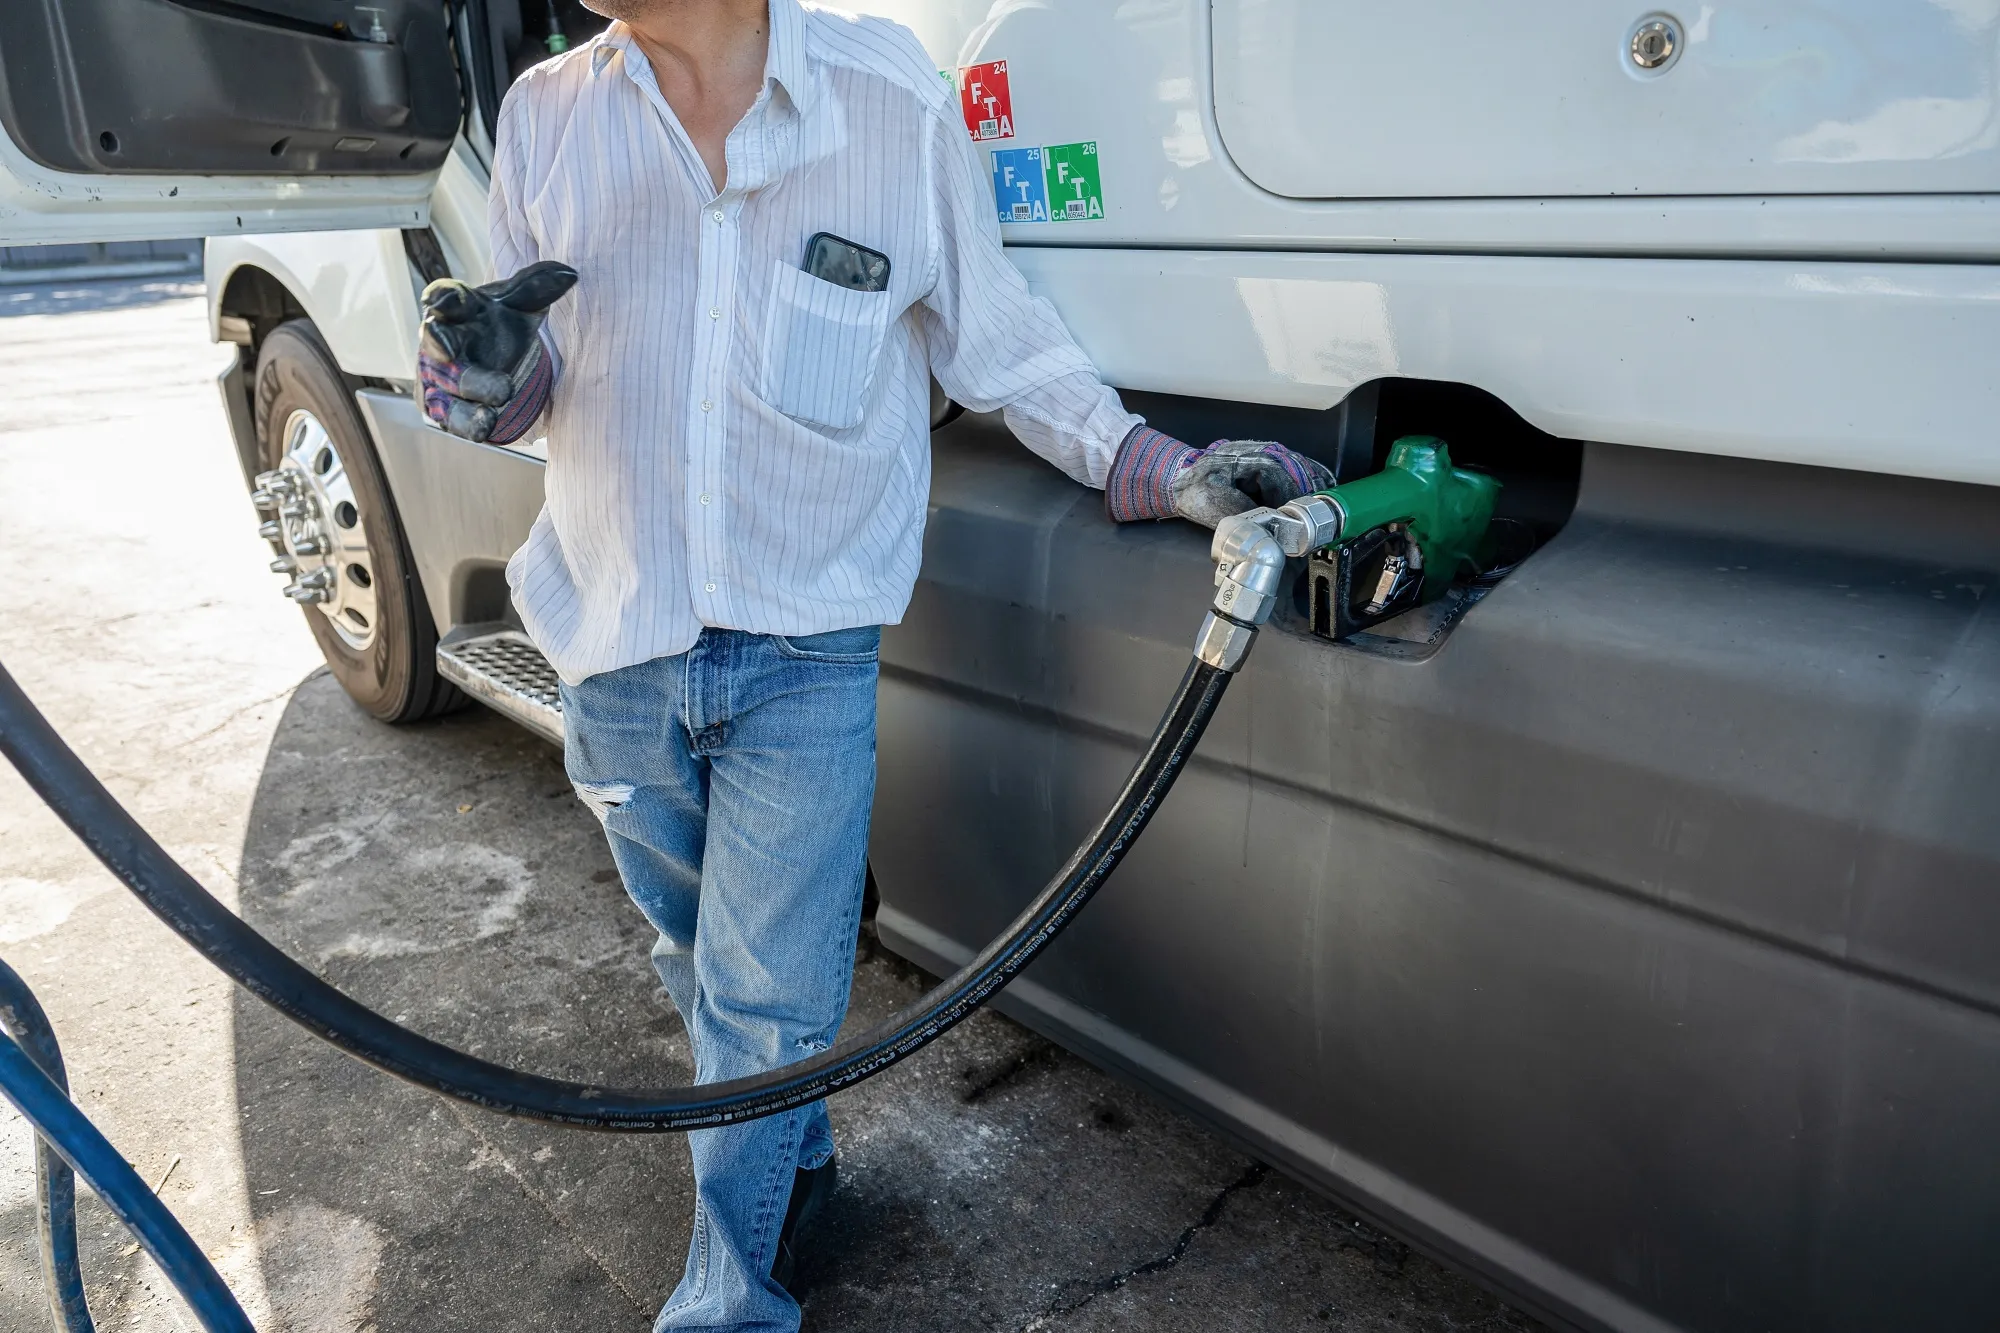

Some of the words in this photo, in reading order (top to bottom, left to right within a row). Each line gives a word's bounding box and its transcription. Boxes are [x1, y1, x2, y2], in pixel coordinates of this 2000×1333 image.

[994, 62, 1006, 75] 24
[1027, 149, 1040, 161] 25
[1082, 143, 1096, 155] 26
[999, 211, 1013, 222] CA
[1052, 209, 1067, 220] CA
[1111, 793, 1156, 851] FUTURA
[1009, 930, 1049, 969] Continental
[967, 974, 1004, 1005] ContiTech
[935, 1007, 962, 1029] (25.4mm)
[896, 1035, 923, 1054] FLEXSTEEL
[829, 1051, 896, 1088] FUTURA
[800, 1083, 827, 1100] GASOLINE
[785, 1093, 801, 1105] HOSE
[733, 1109, 745, 1118] USA
[745, 1107, 753, 1115] IN
[753, 1103, 770, 1113] MADE
[609, 1119, 655, 1128] ContiTech
[668, 1112, 722, 1127] Continental
